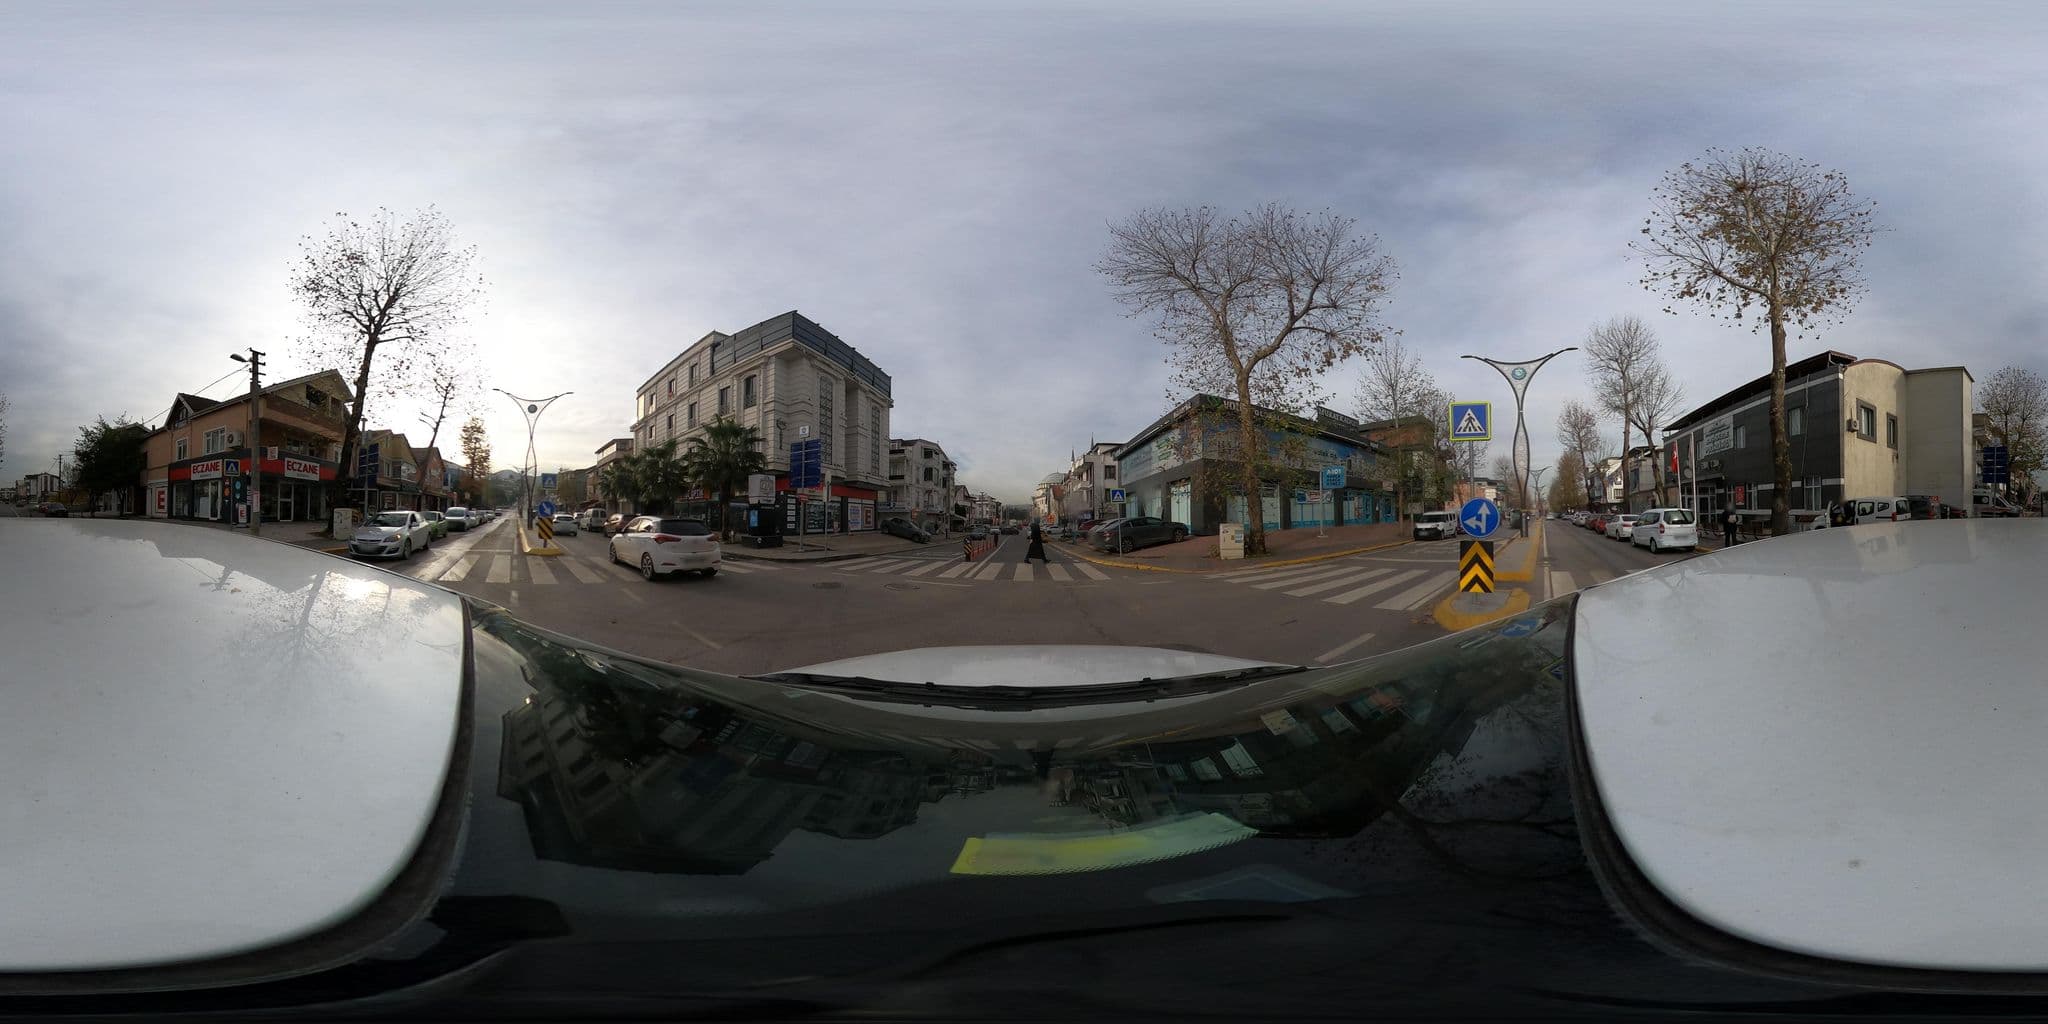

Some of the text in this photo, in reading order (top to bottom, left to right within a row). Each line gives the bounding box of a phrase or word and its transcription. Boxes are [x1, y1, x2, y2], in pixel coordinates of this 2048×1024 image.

[193, 461, 220, 474] ECZANE
[287, 460, 318, 475] ECZANE
[158, 491, 165, 509] E
[240, 509, 246, 518] E
